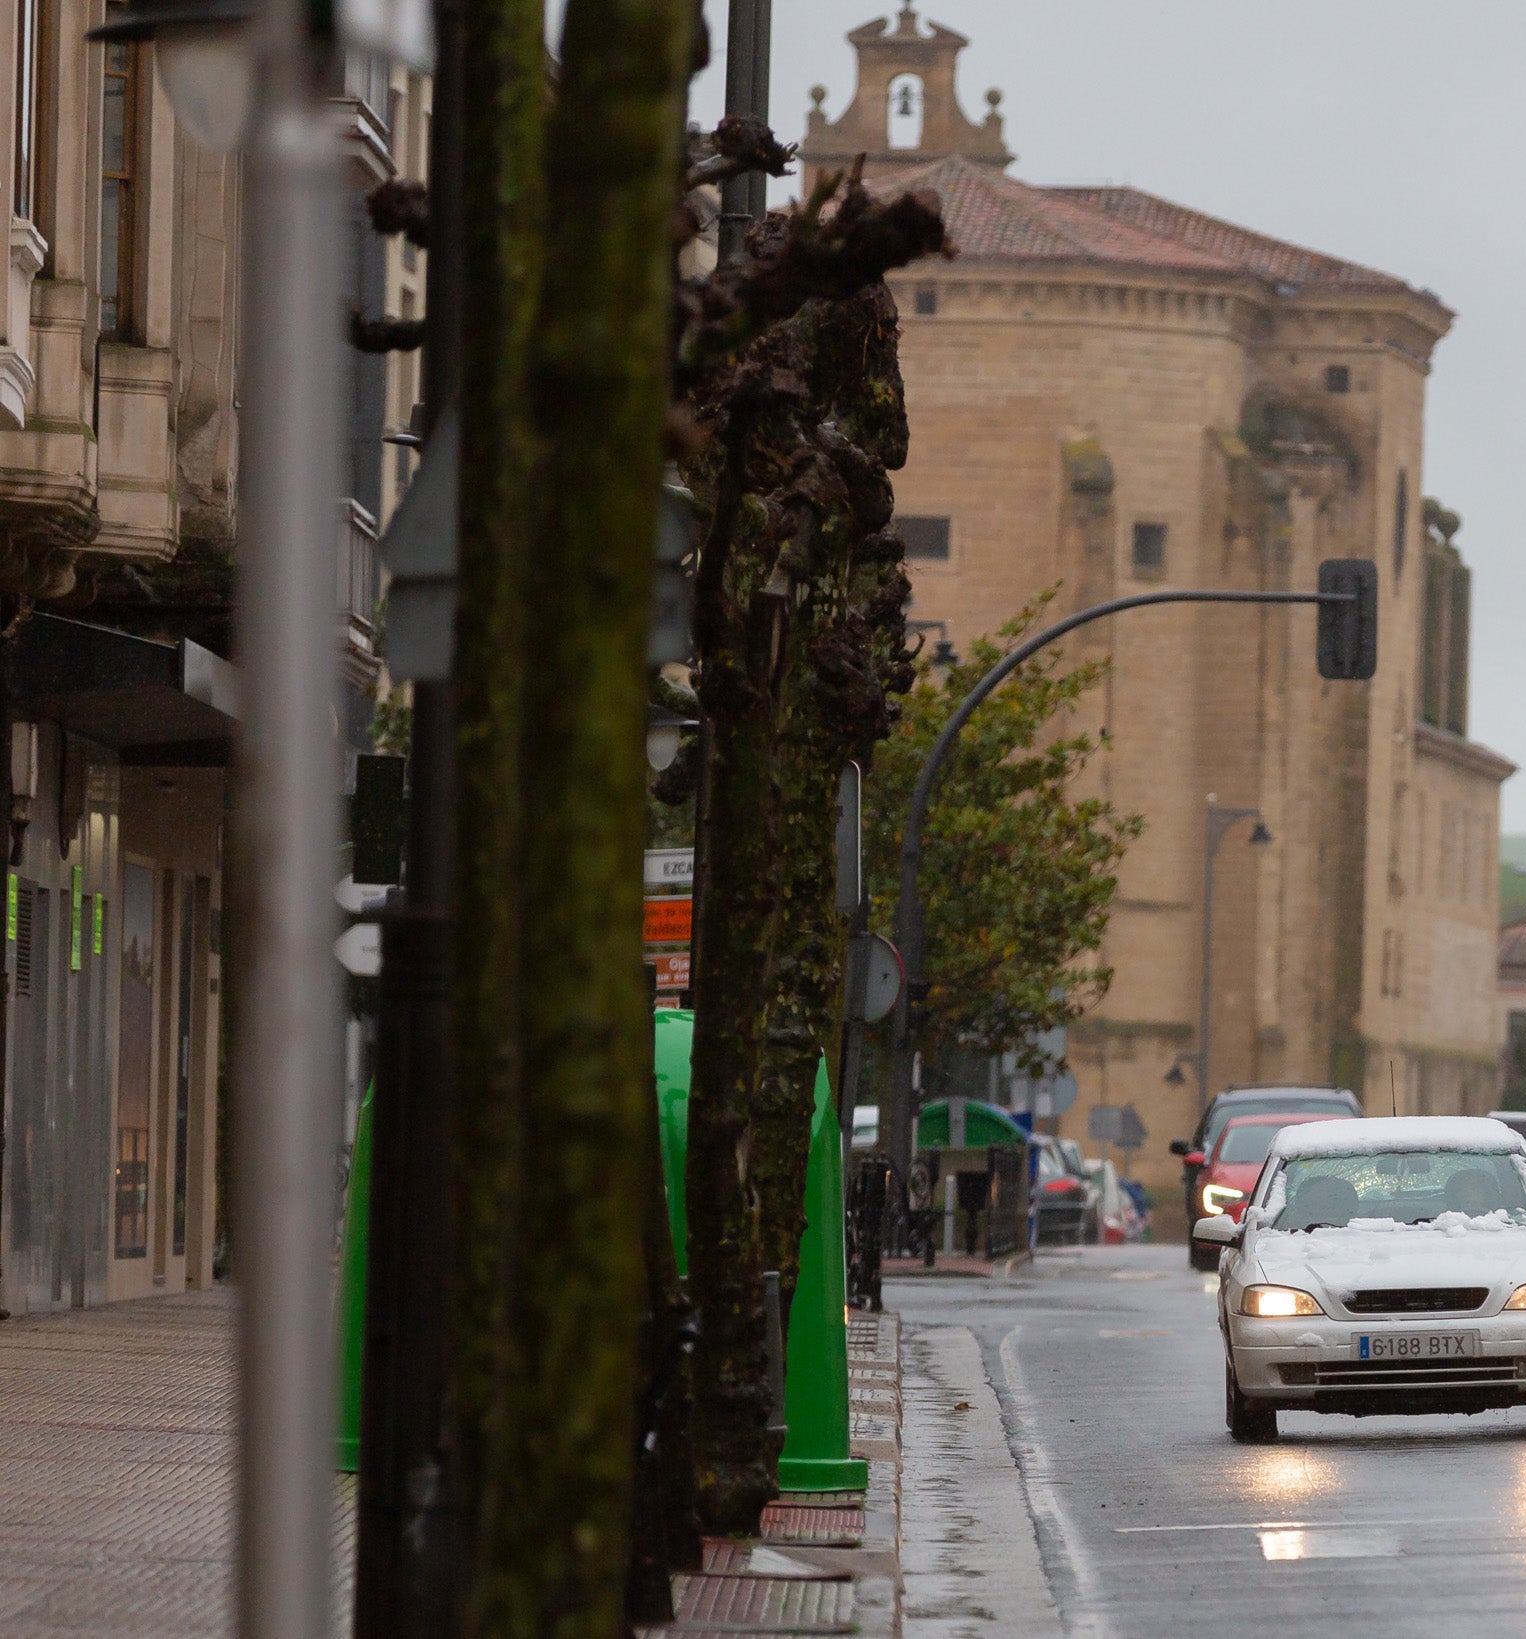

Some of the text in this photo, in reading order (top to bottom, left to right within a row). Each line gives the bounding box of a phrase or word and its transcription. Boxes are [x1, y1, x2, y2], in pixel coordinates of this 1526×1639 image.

[663, 860, 694, 876] EZCA
[1372, 1335, 1465, 1357] 6188 BTX
